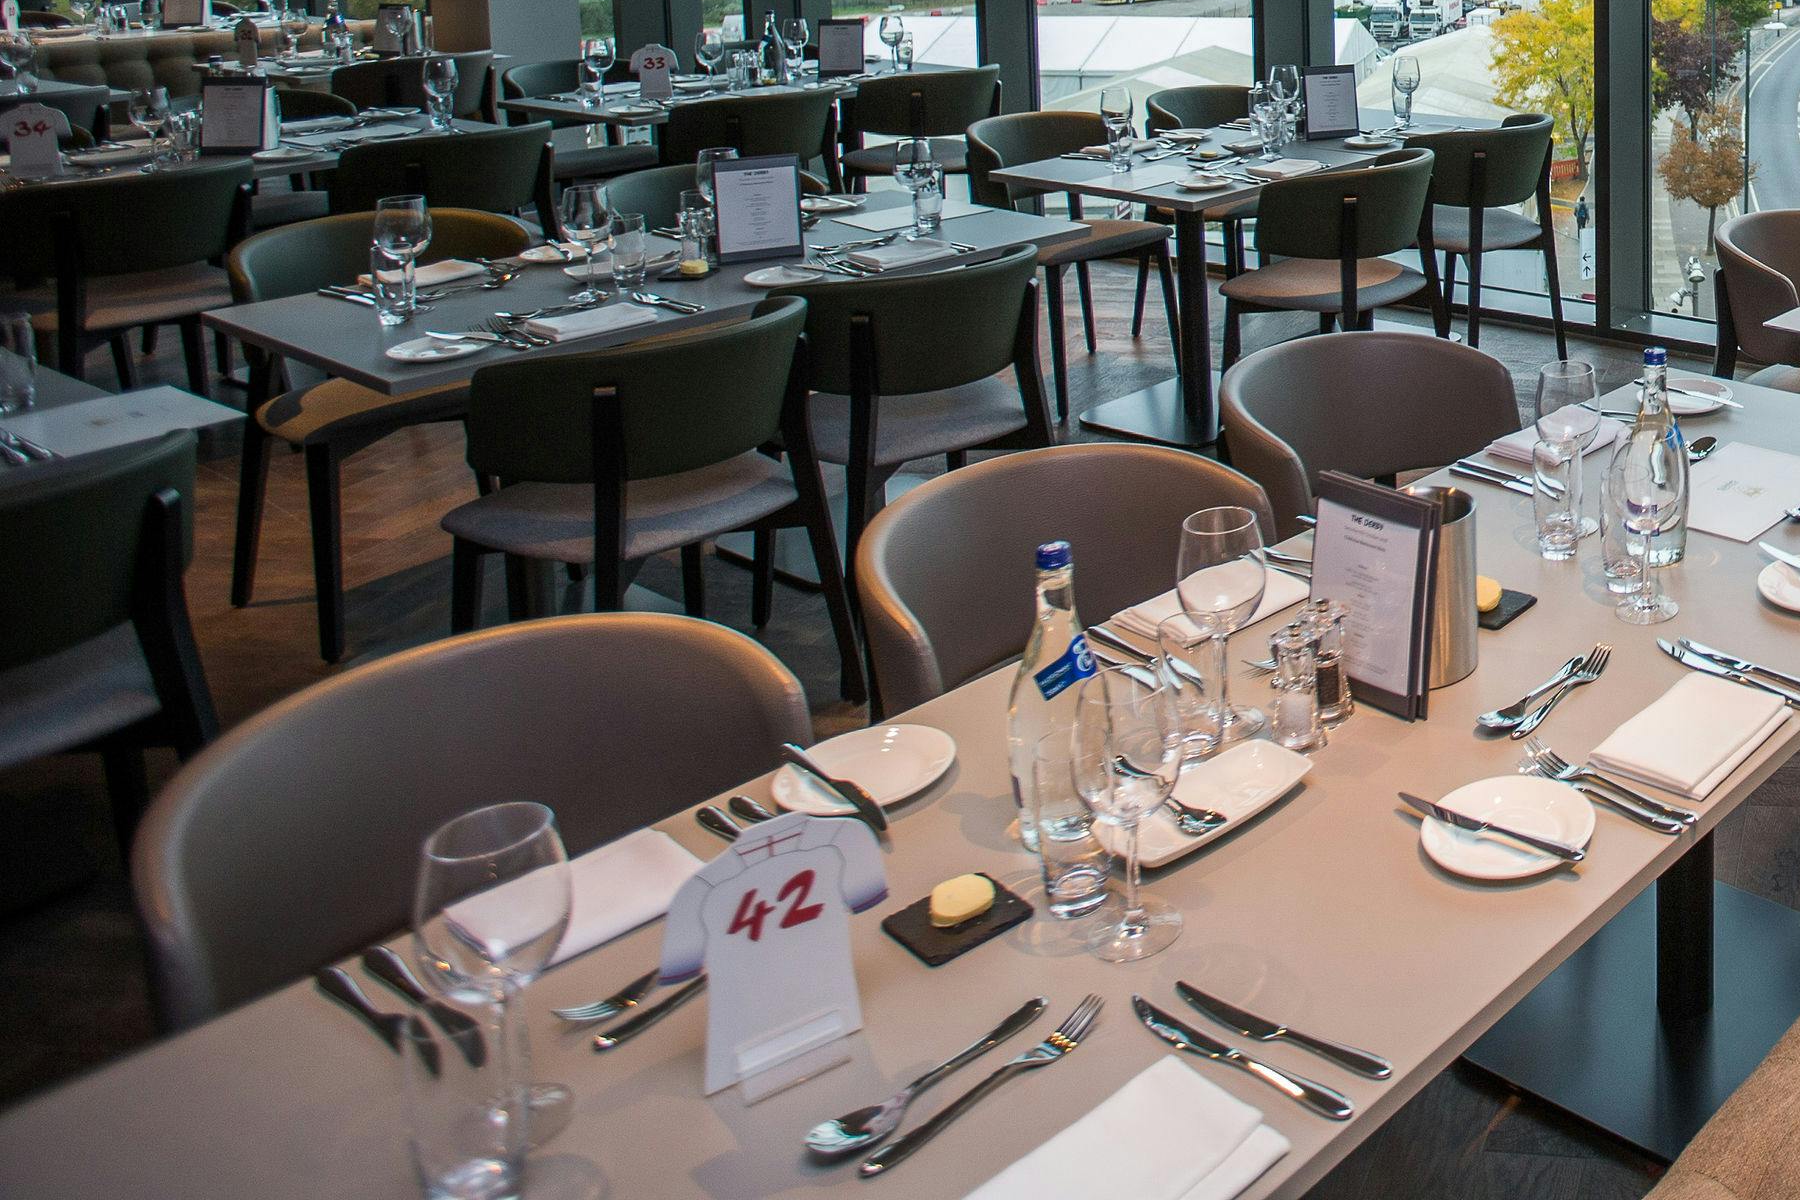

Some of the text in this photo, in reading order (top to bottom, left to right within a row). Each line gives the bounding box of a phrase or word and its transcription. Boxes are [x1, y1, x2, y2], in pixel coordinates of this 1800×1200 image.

[643, 56, 666, 69] 33
[13, 119, 53, 137] 34
[1351, 514, 1363, 525] THE
[727, 869, 825, 941] 42
